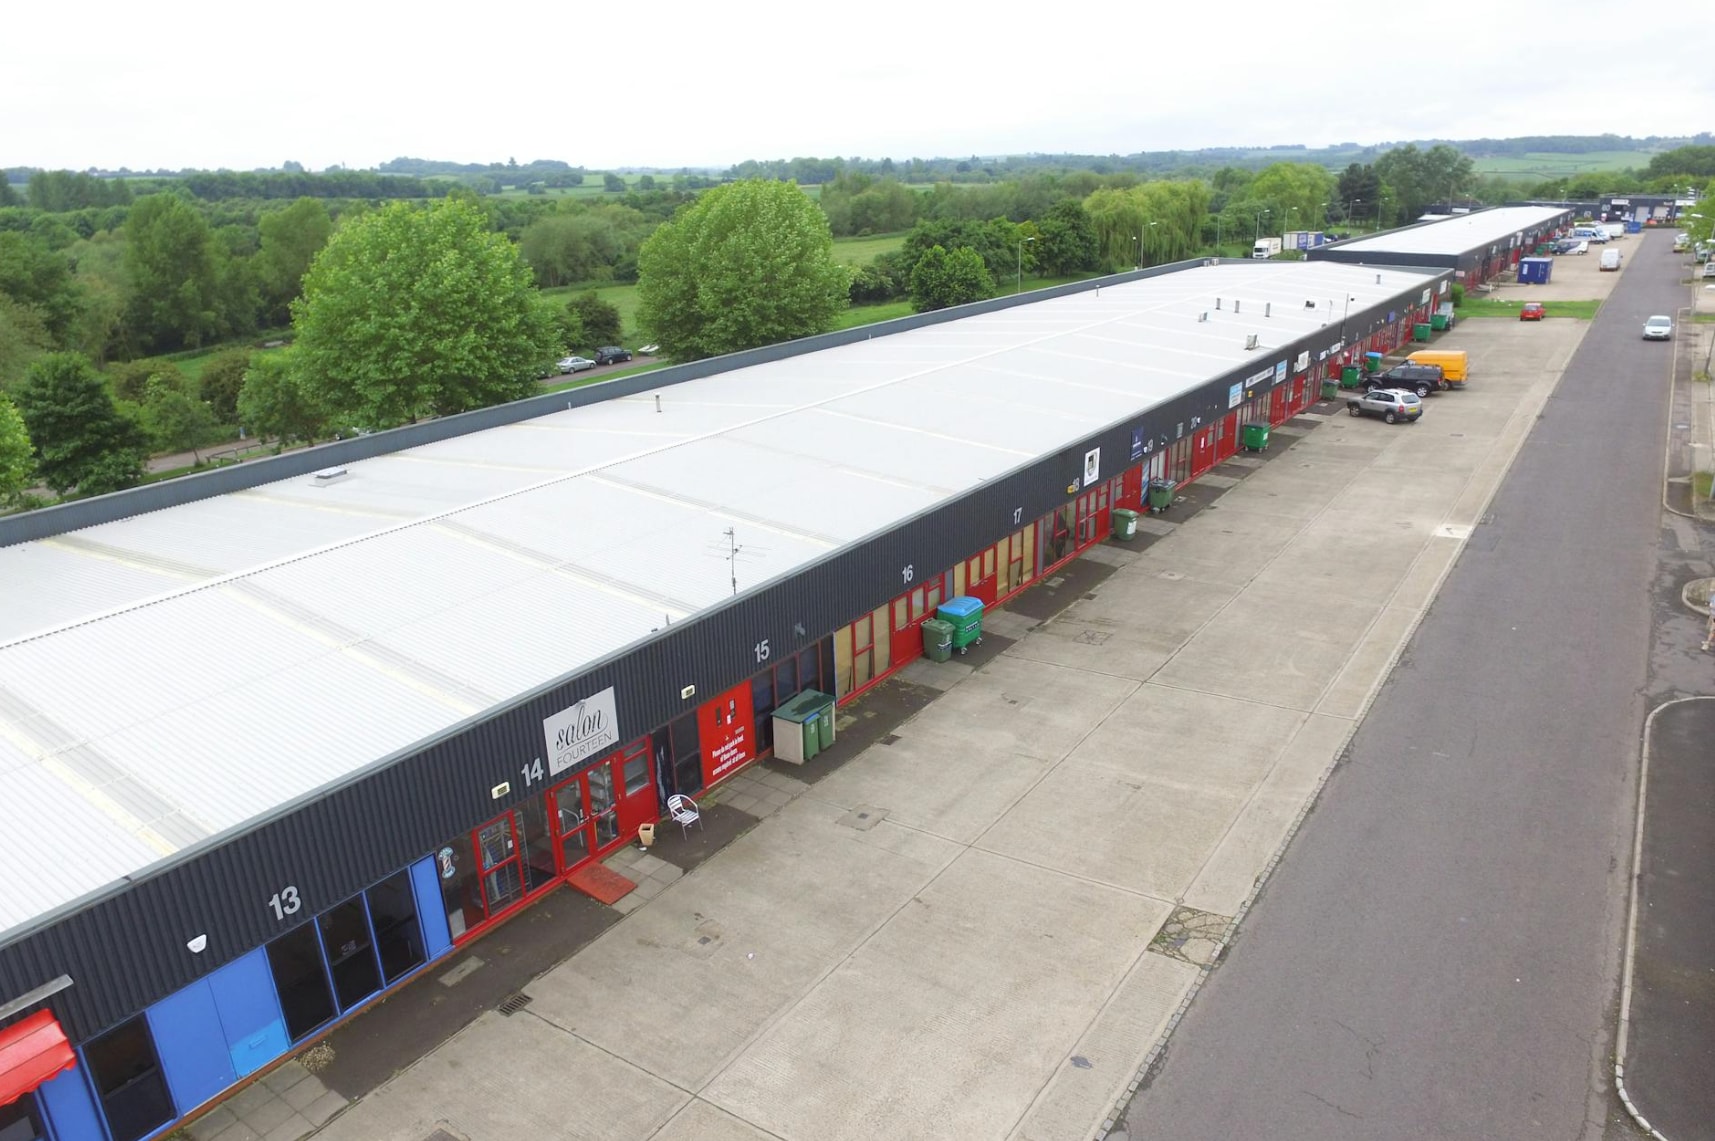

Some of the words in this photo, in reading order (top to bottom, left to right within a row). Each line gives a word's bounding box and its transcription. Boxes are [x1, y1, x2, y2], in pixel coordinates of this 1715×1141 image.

[1013, 507, 1023, 525] 17
[902, 564, 913, 584] 16
[754, 639, 770, 663] 15
[556, 705, 606, 752] salon
[557, 731, 612, 767] FOURTEEN
[521, 757, 544, 787] 14
[268, 886, 301, 920] 13
